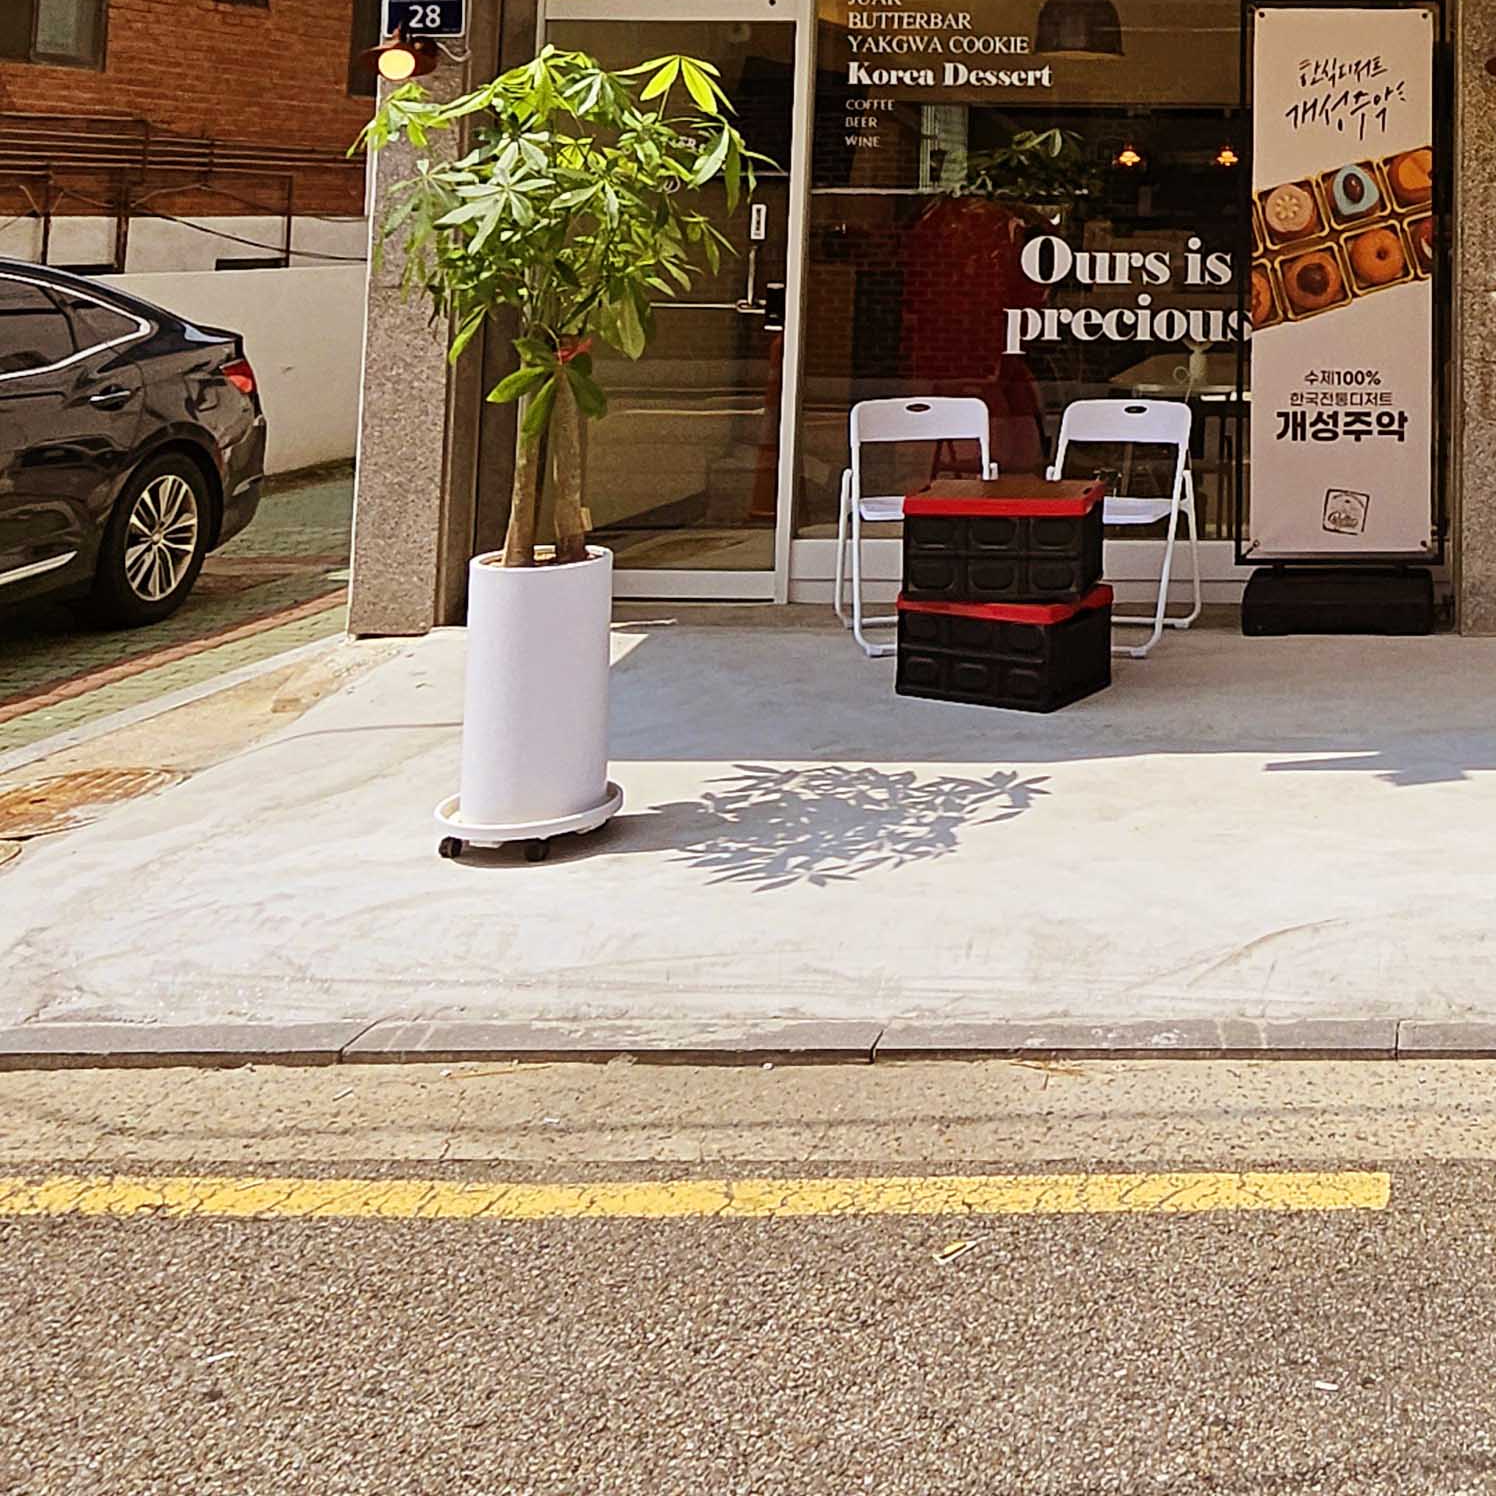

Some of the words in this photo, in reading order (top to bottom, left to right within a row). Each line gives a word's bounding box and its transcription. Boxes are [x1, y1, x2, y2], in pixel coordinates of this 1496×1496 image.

[408, 4, 441, 28] 28
[847, 11, 972, 30] BUTTERBAR
[847, 35, 943, 54] YAKGWA
[949, 36, 1029, 54] COOKIE
[847, 62, 935, 86] Korea
[942, 62, 1053, 88] Dessert
[845, 99, 896, 111] COFFEE
[845, 116, 878, 128] BEER
[844, 135, 881, 148] WINE
[1020, 235, 1171, 285] Ours
[1183, 237, 1233, 285] is
[1002, 293, 1253, 354] precious
[1304, 370, 1382, 387] 수제100%
[1290, 391, 1393, 407] 한국전통디저트
[1276, 410, 1408, 442] 개성주악
